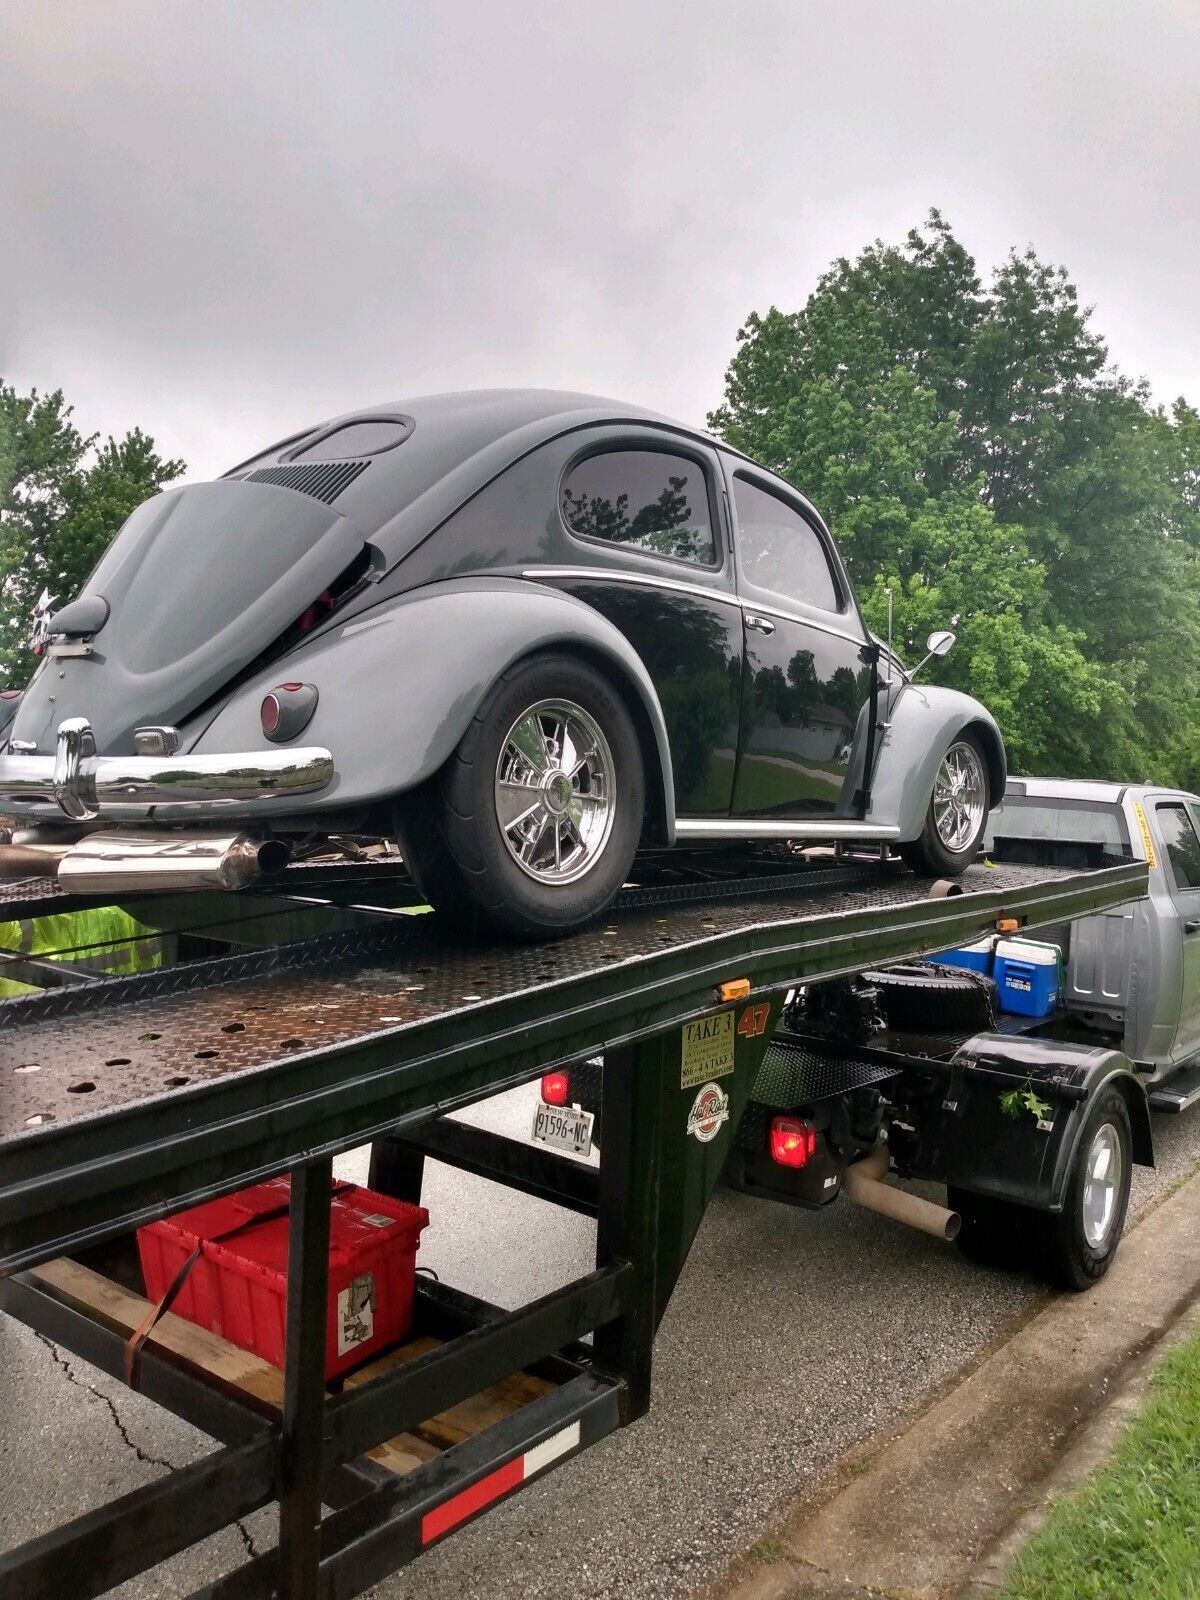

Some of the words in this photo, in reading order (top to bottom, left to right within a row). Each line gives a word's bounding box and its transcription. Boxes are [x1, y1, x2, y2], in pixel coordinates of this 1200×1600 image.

[687, 1017, 720, 1042] TAKE
[724, 1013, 731, 1033] 3
[738, 1003, 770, 1038] 47
